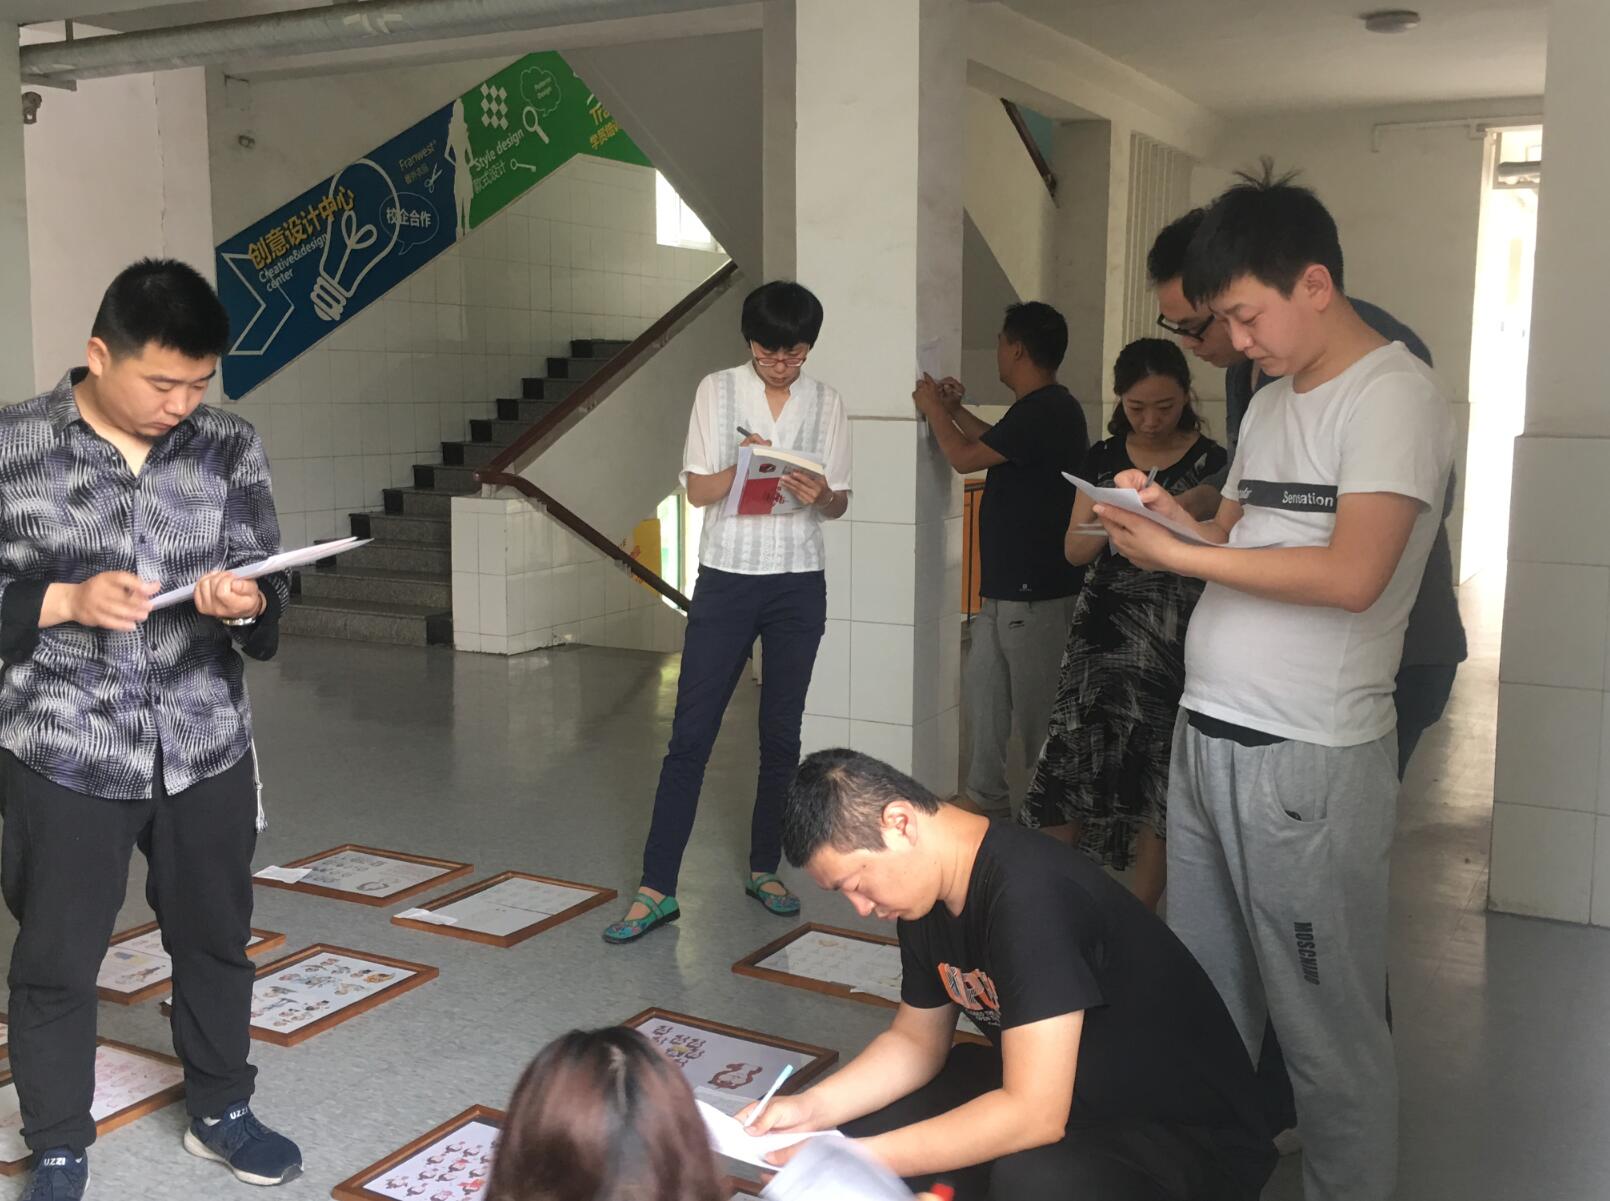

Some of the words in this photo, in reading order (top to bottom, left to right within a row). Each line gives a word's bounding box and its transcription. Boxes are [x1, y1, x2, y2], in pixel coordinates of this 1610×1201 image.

[474, 149, 496, 171] Style
[496, 129, 524, 154] design
[248, 185, 354, 270] 创意设计中心
[386, 207, 432, 229] 校企合作
[258, 232, 328, 282] Creative&design
[266, 268, 294, 292] center
[1282, 490, 1334, 507] Sensation
[43, 1156, 66, 1167] UZZI
